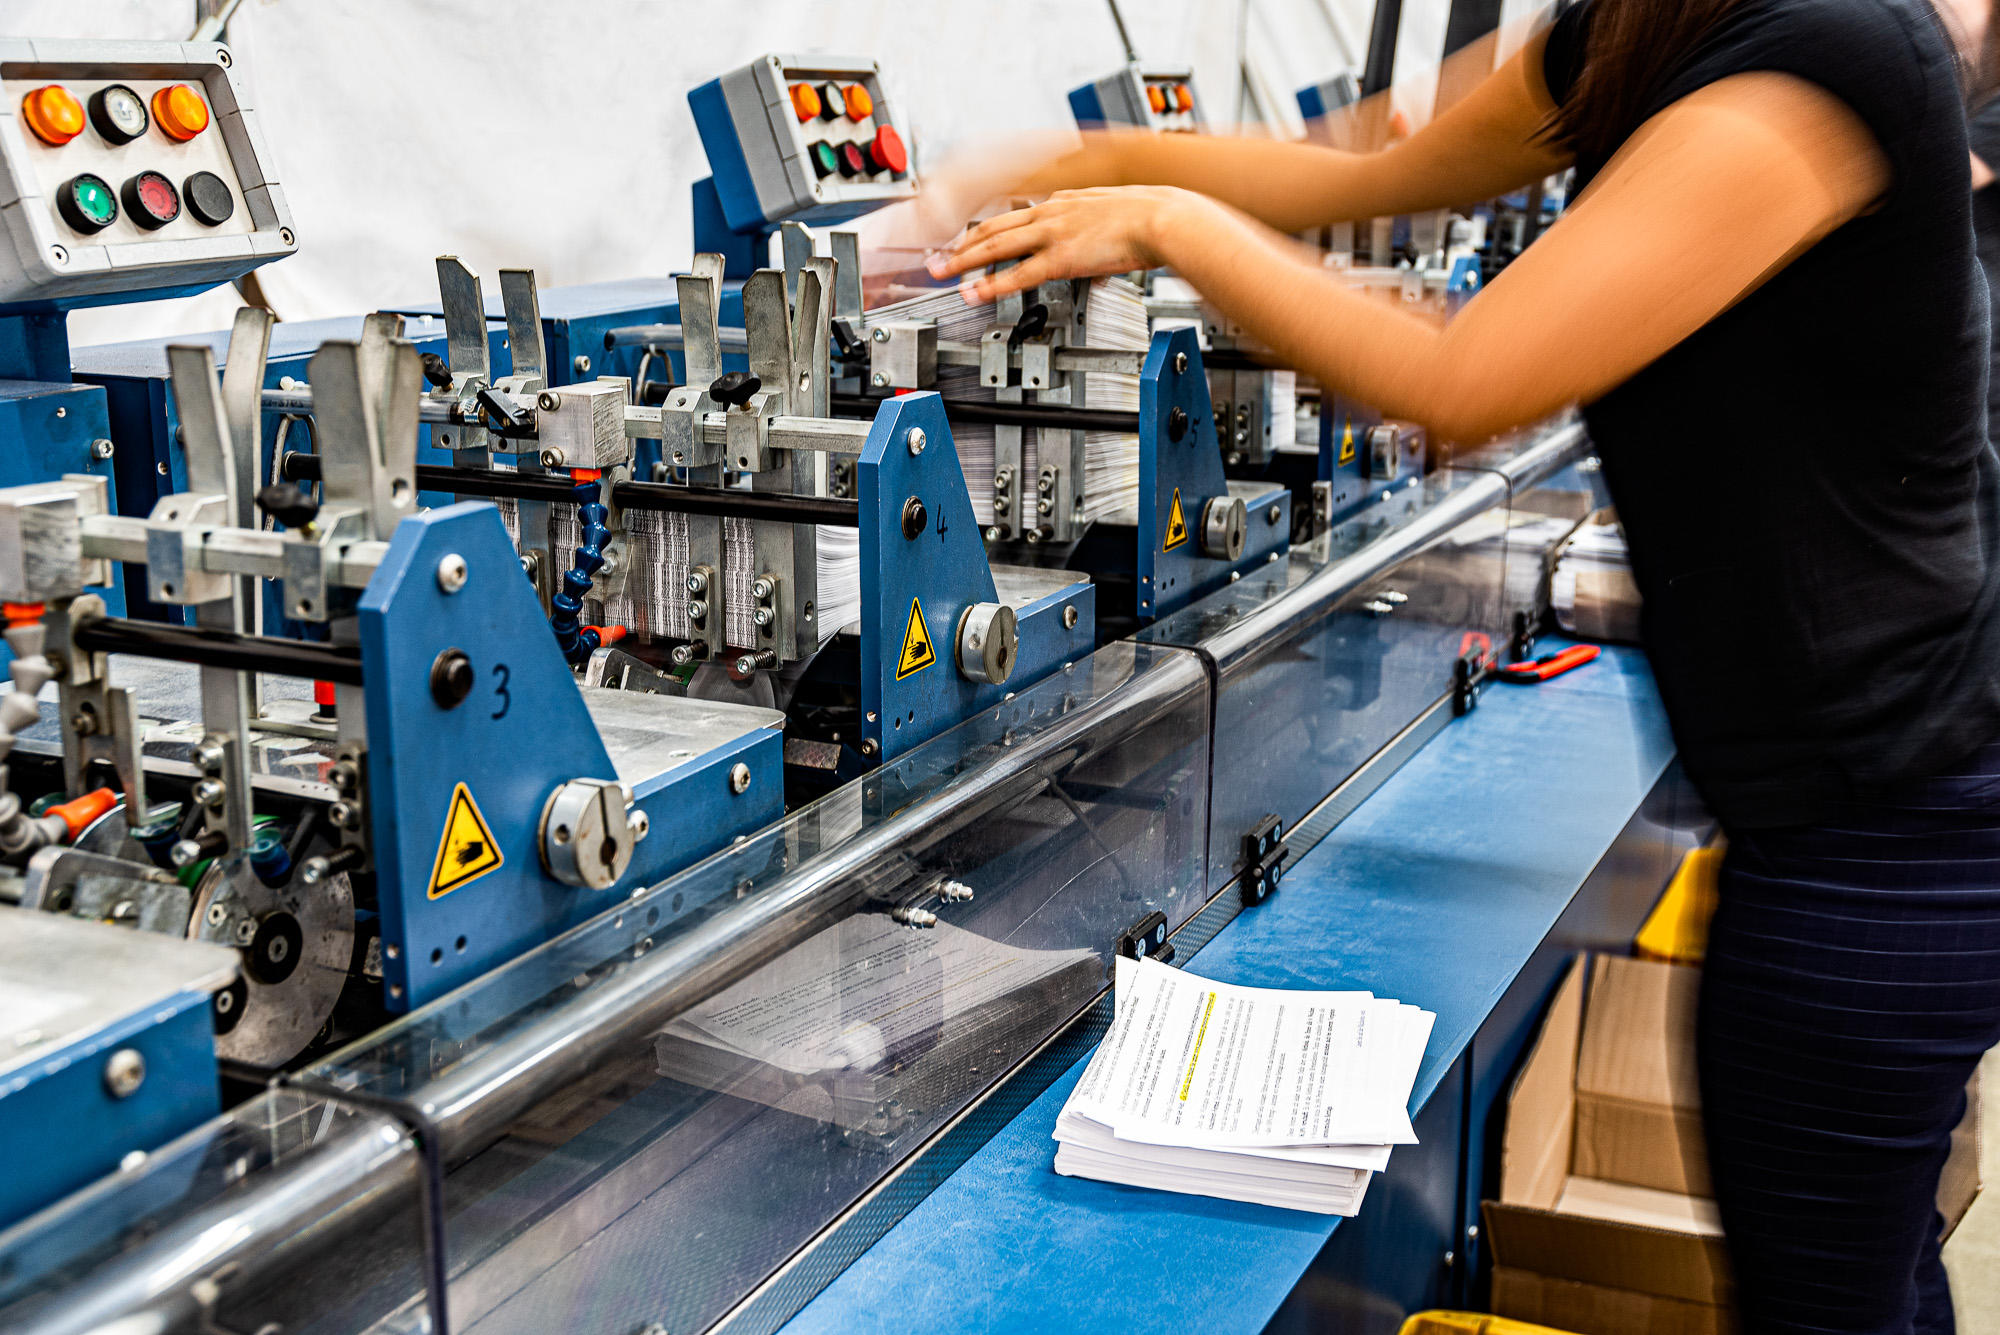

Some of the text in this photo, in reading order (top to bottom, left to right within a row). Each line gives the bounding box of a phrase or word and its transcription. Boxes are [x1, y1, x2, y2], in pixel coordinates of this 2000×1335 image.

[1188, 415, 1202, 449] 5
[936, 503, 949, 545] 4
[491, 662, 512, 721] 3
